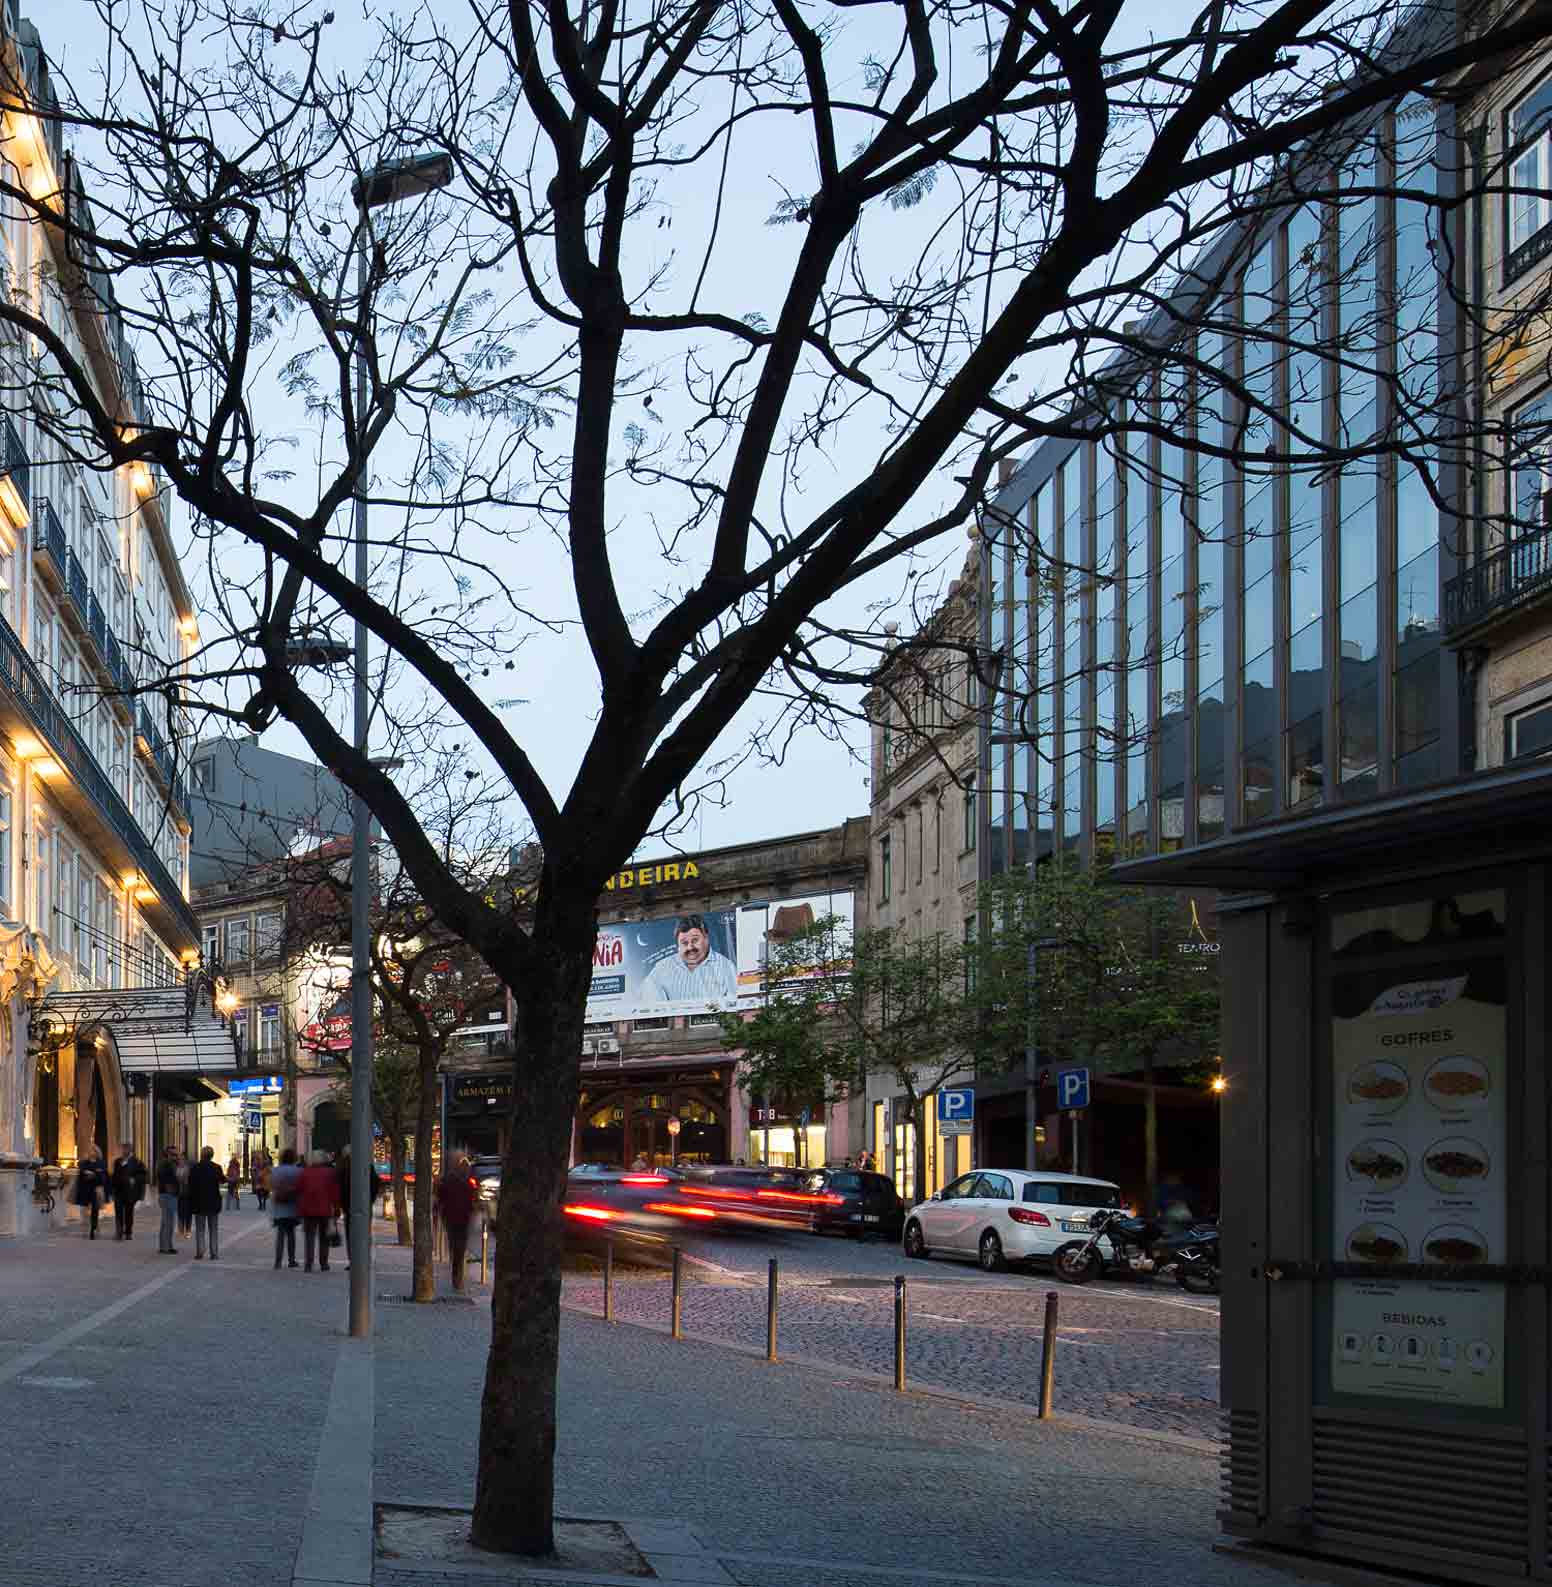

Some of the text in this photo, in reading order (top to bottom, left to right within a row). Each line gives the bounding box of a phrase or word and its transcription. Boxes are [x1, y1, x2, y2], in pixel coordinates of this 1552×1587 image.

[1178, 943, 1221, 953] TEATRO
[1381, 1029, 1455, 1047] GOFRES
[1064, 1075, 1080, 1105] P
[944, 1093, 965, 1118] P
[1383, 1312, 1448, 1328] BEBIDAS
